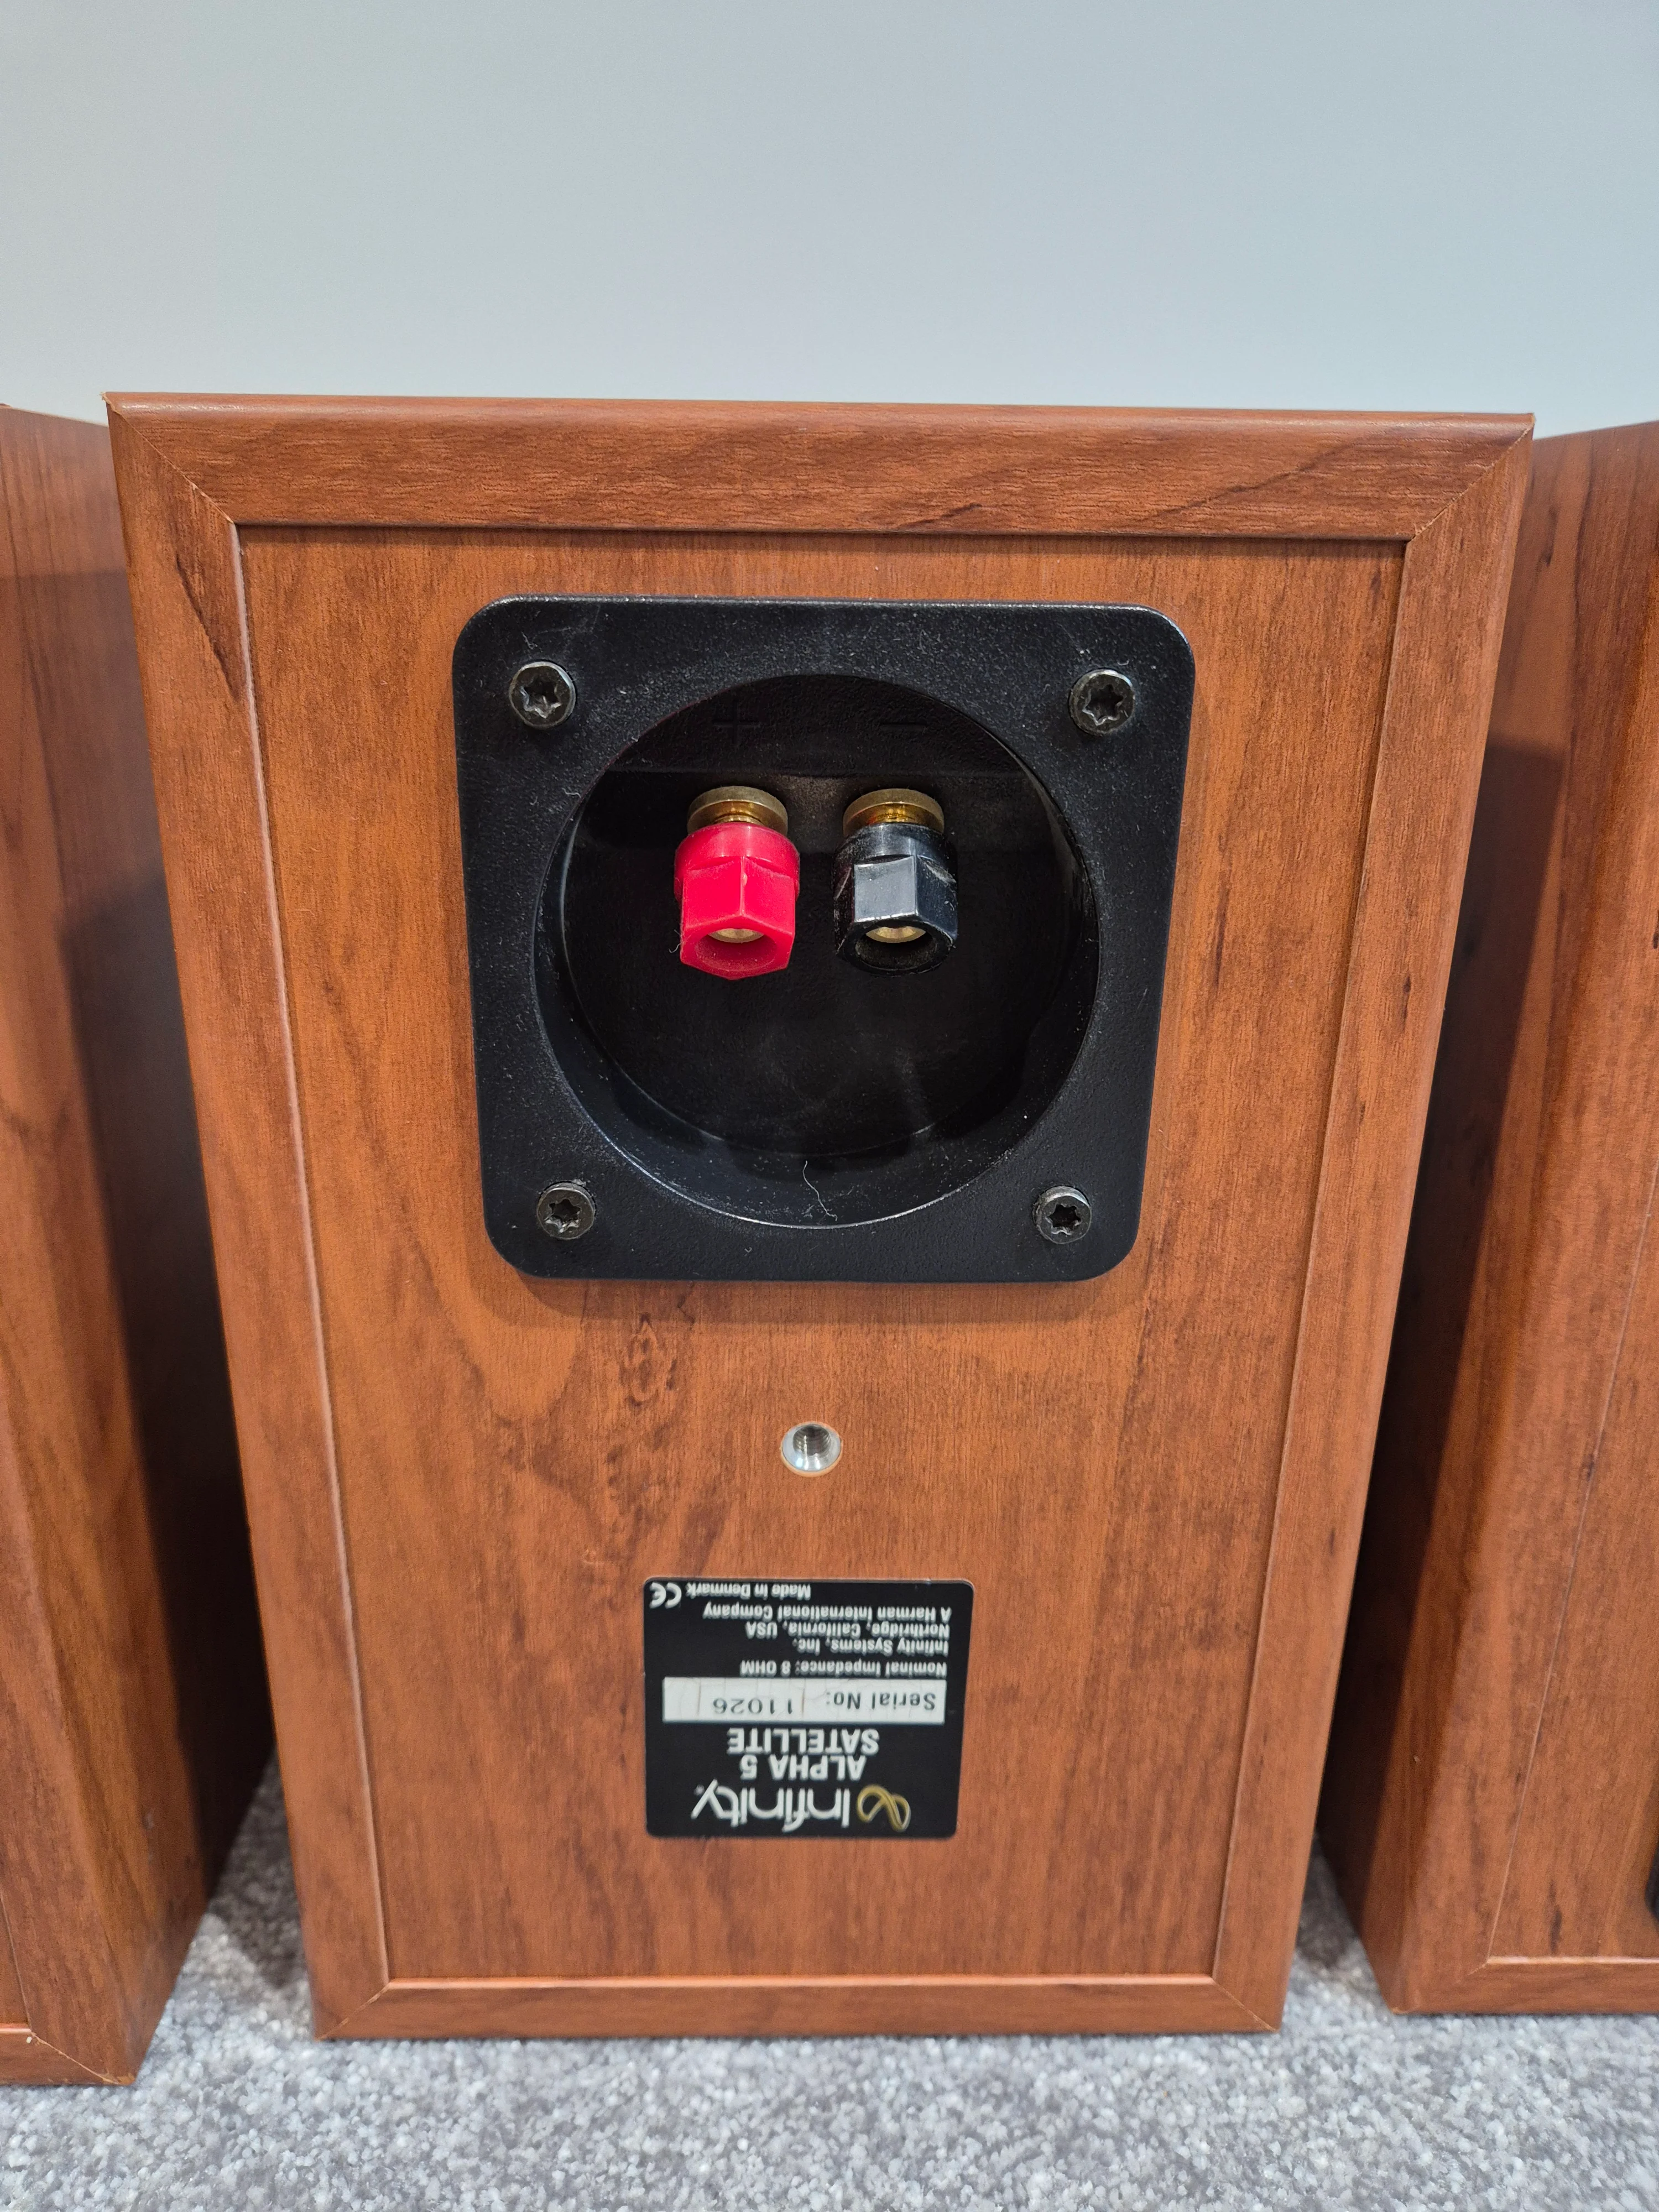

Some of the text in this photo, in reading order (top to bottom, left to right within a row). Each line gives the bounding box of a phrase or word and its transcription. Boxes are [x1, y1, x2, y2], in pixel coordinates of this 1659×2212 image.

[686, 1583, 811, 1600] Made in Denmark
[702, 1601, 952, 1623] A Harman International Company
[745, 1620, 951, 1639] Northridge, California, USA
[792, 1637, 949, 1656] Infinity Systems, Inc.
[740, 1660, 947, 1678] Nominal Impedance: 8 OHM
[713, 1691, 936, 1715] Serial No: 11026
[727, 1728, 879, 1754] SATELLITE
[740, 1755, 867, 1781] ALPHA 5
[691, 1779, 851, 1832] Infinity
